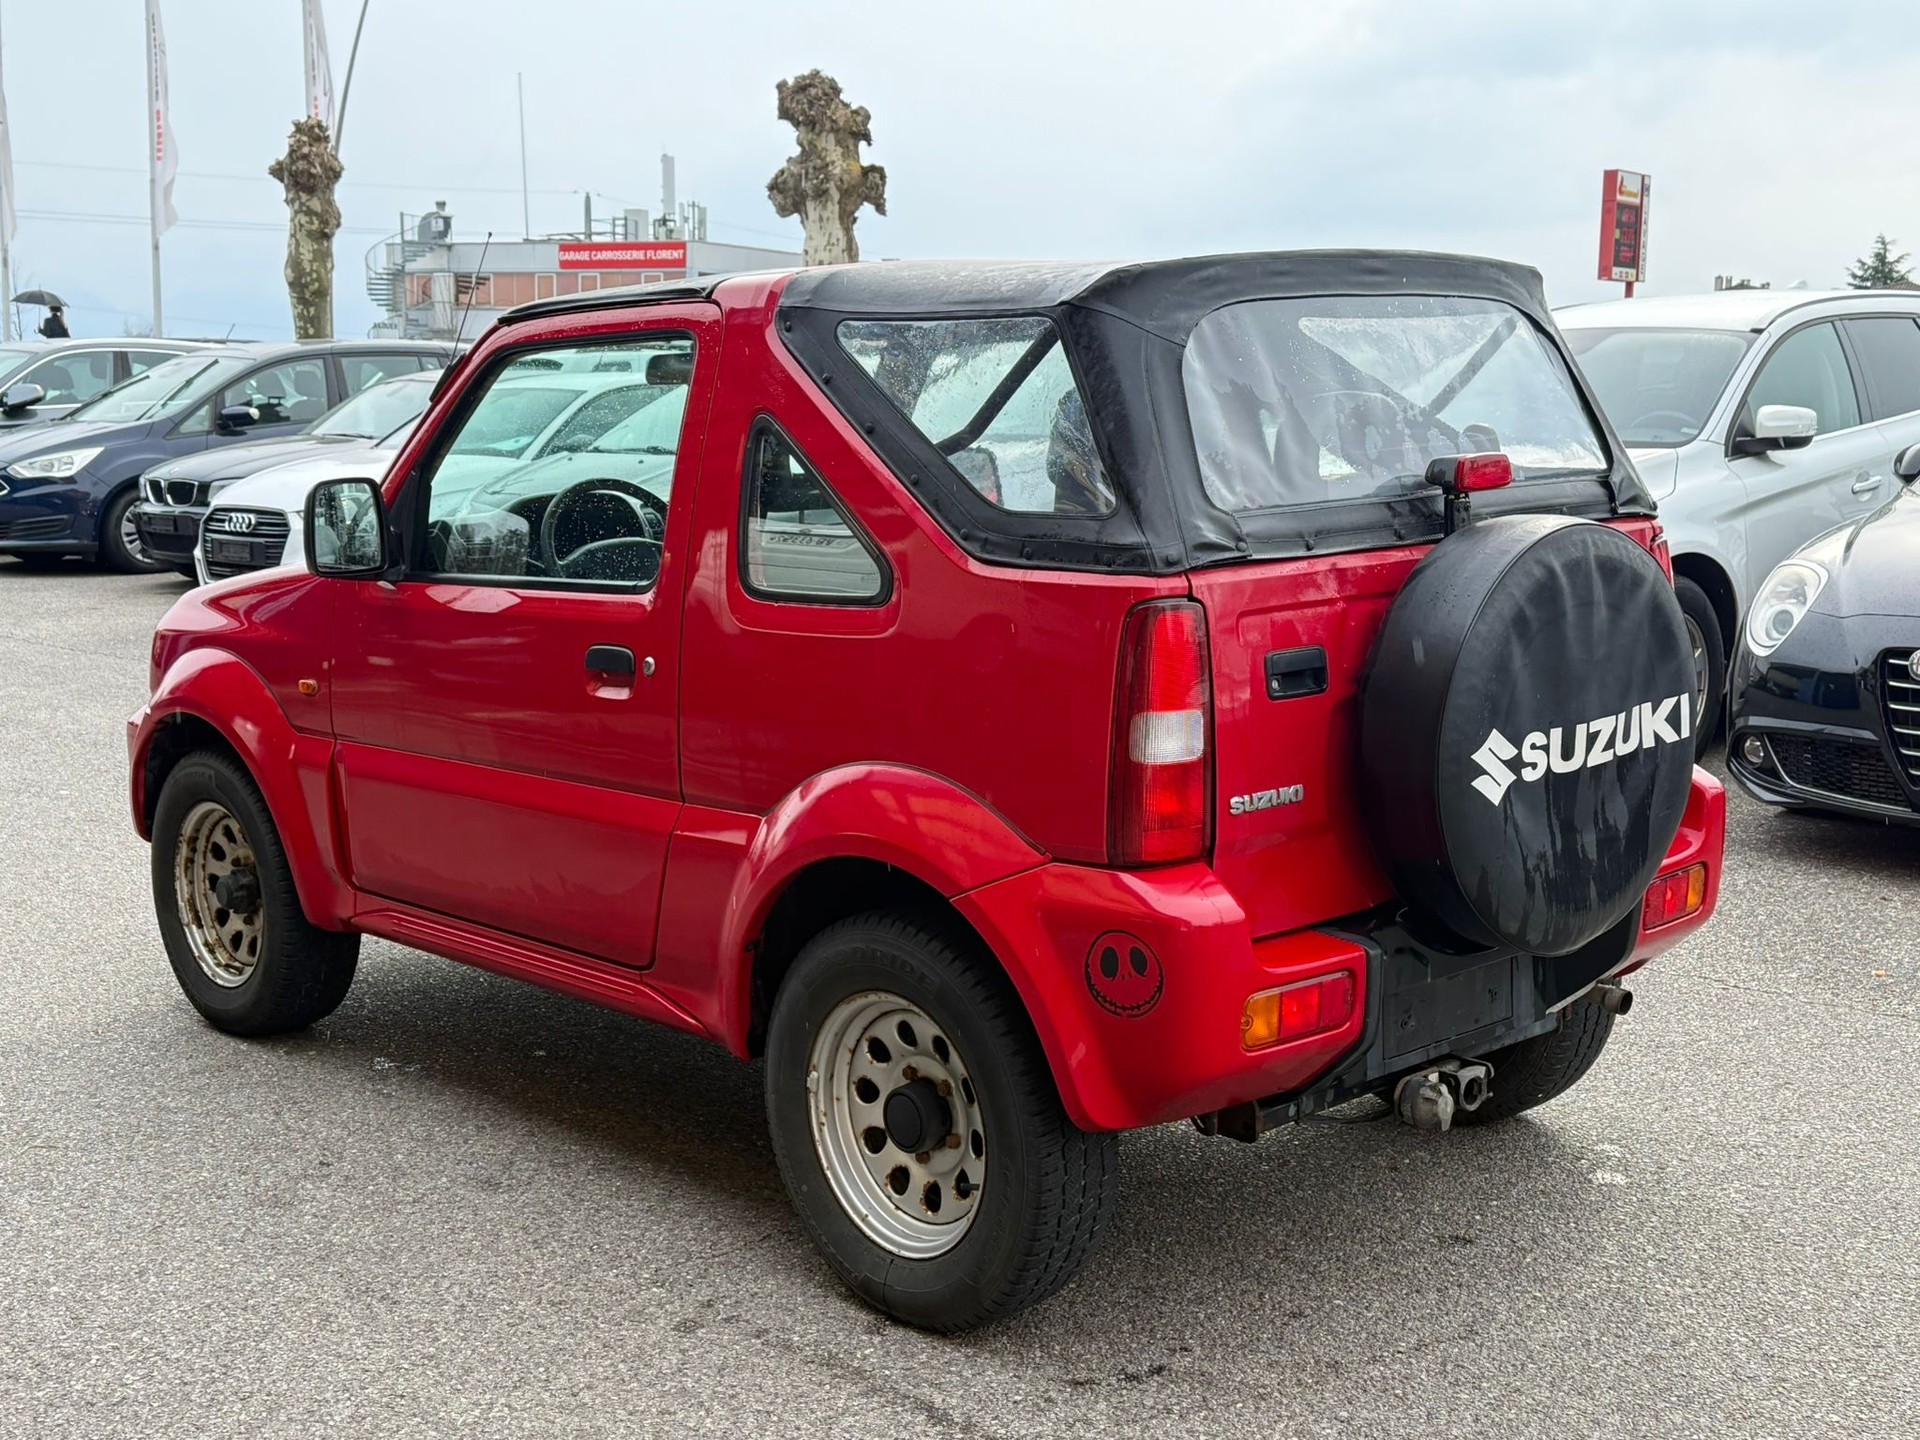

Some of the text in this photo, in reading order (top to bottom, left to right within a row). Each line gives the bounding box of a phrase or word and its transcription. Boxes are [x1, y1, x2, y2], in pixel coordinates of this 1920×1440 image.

[559, 249, 684, 261] GARAGE CARROSSERIE FLORENT
[1521, 693, 1690, 782] SUZUKI
[1230, 784, 1304, 815] SUZUKI
